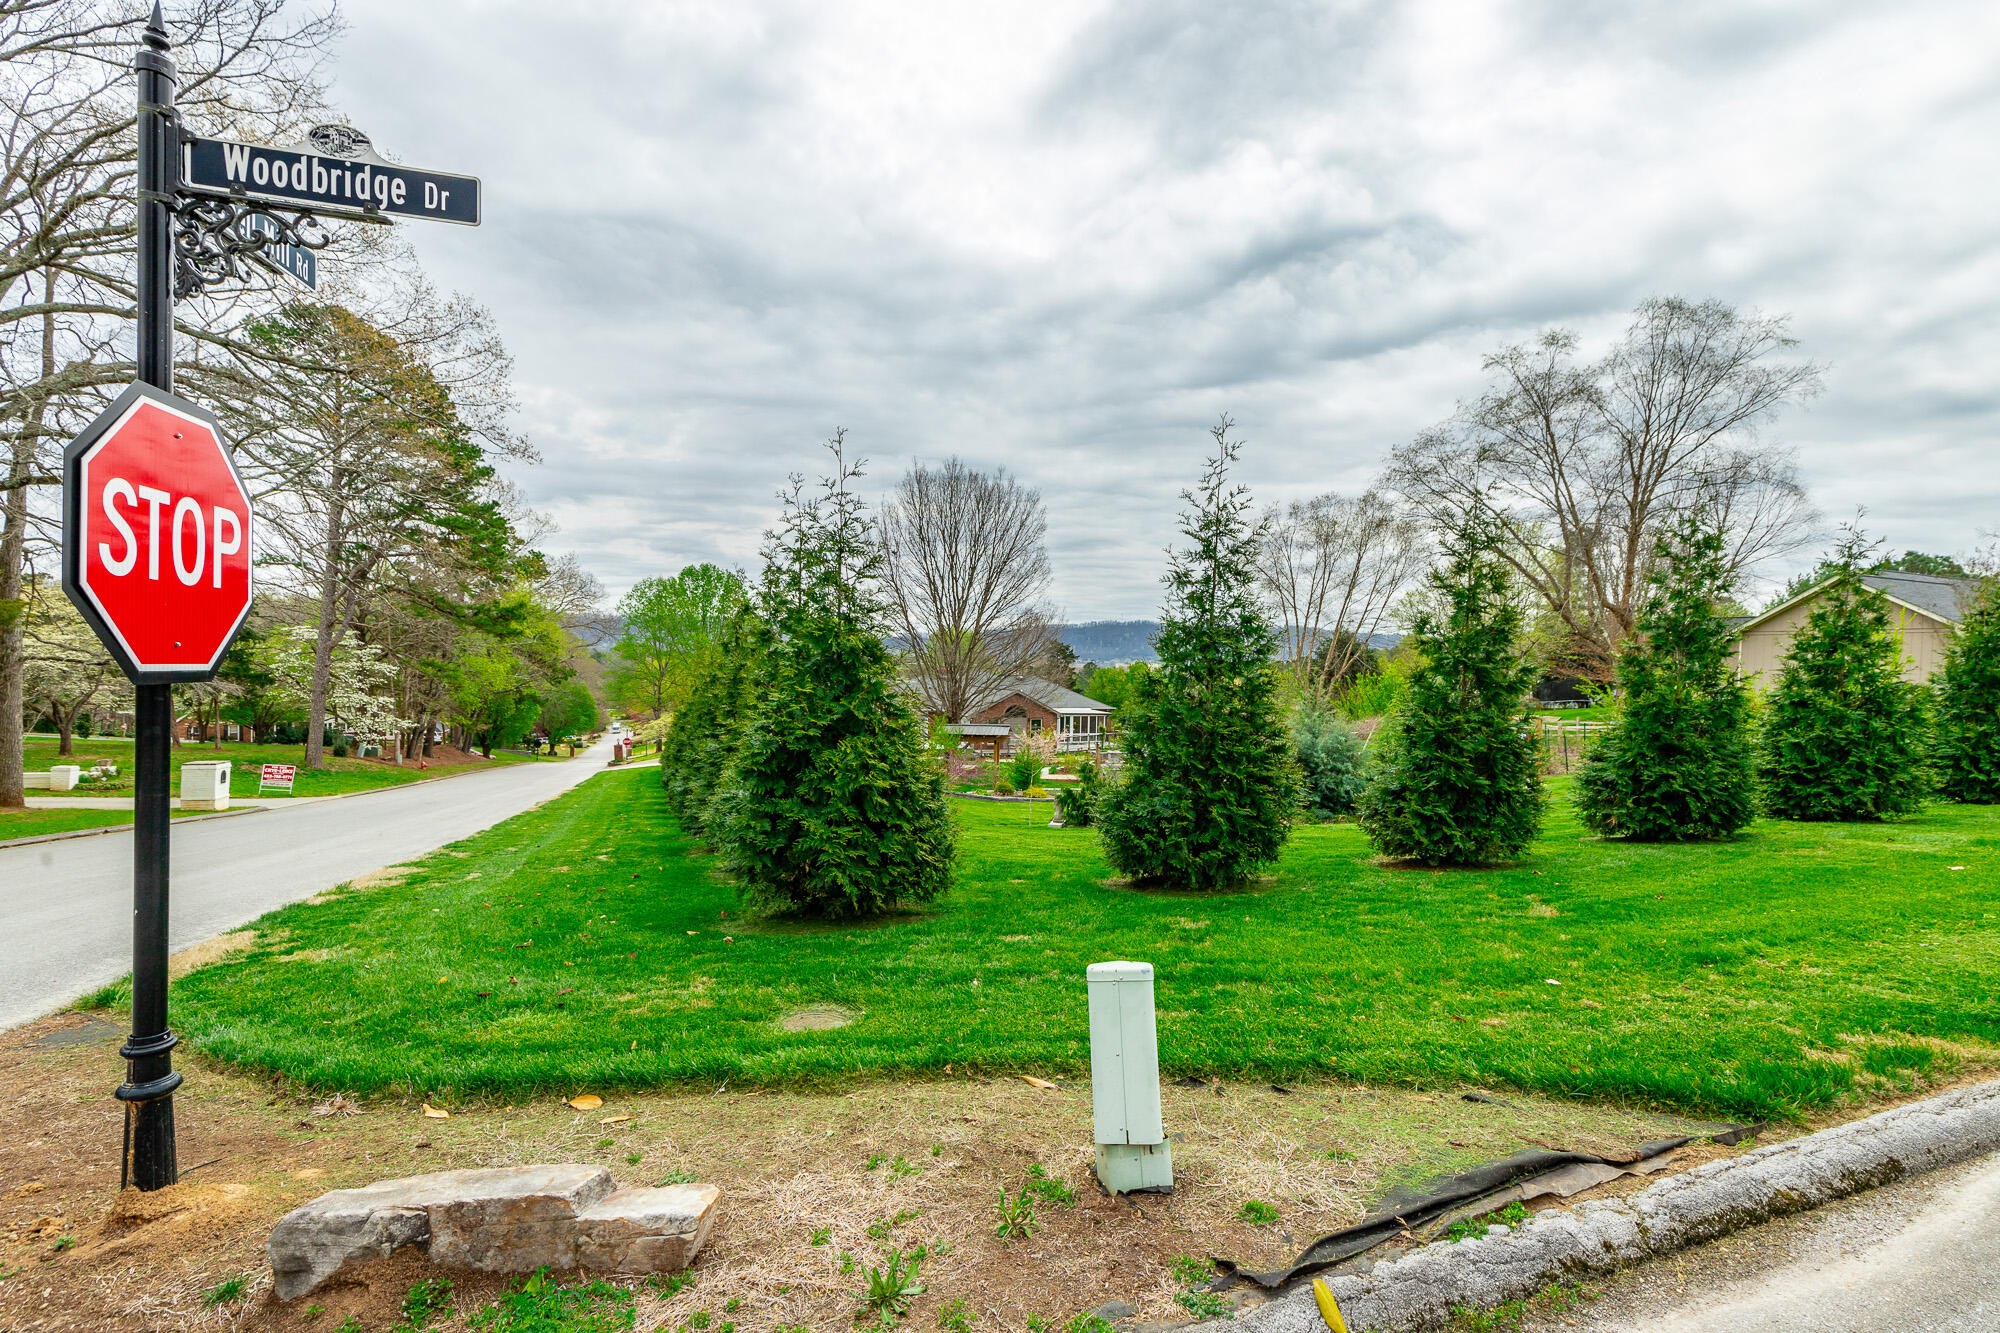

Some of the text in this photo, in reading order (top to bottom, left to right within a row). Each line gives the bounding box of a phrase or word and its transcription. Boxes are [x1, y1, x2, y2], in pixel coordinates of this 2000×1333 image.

[222, 142, 450, 211] Woodbridge Dr
[296, 252, 309, 281] Rd
[98, 477, 242, 589] STOP
